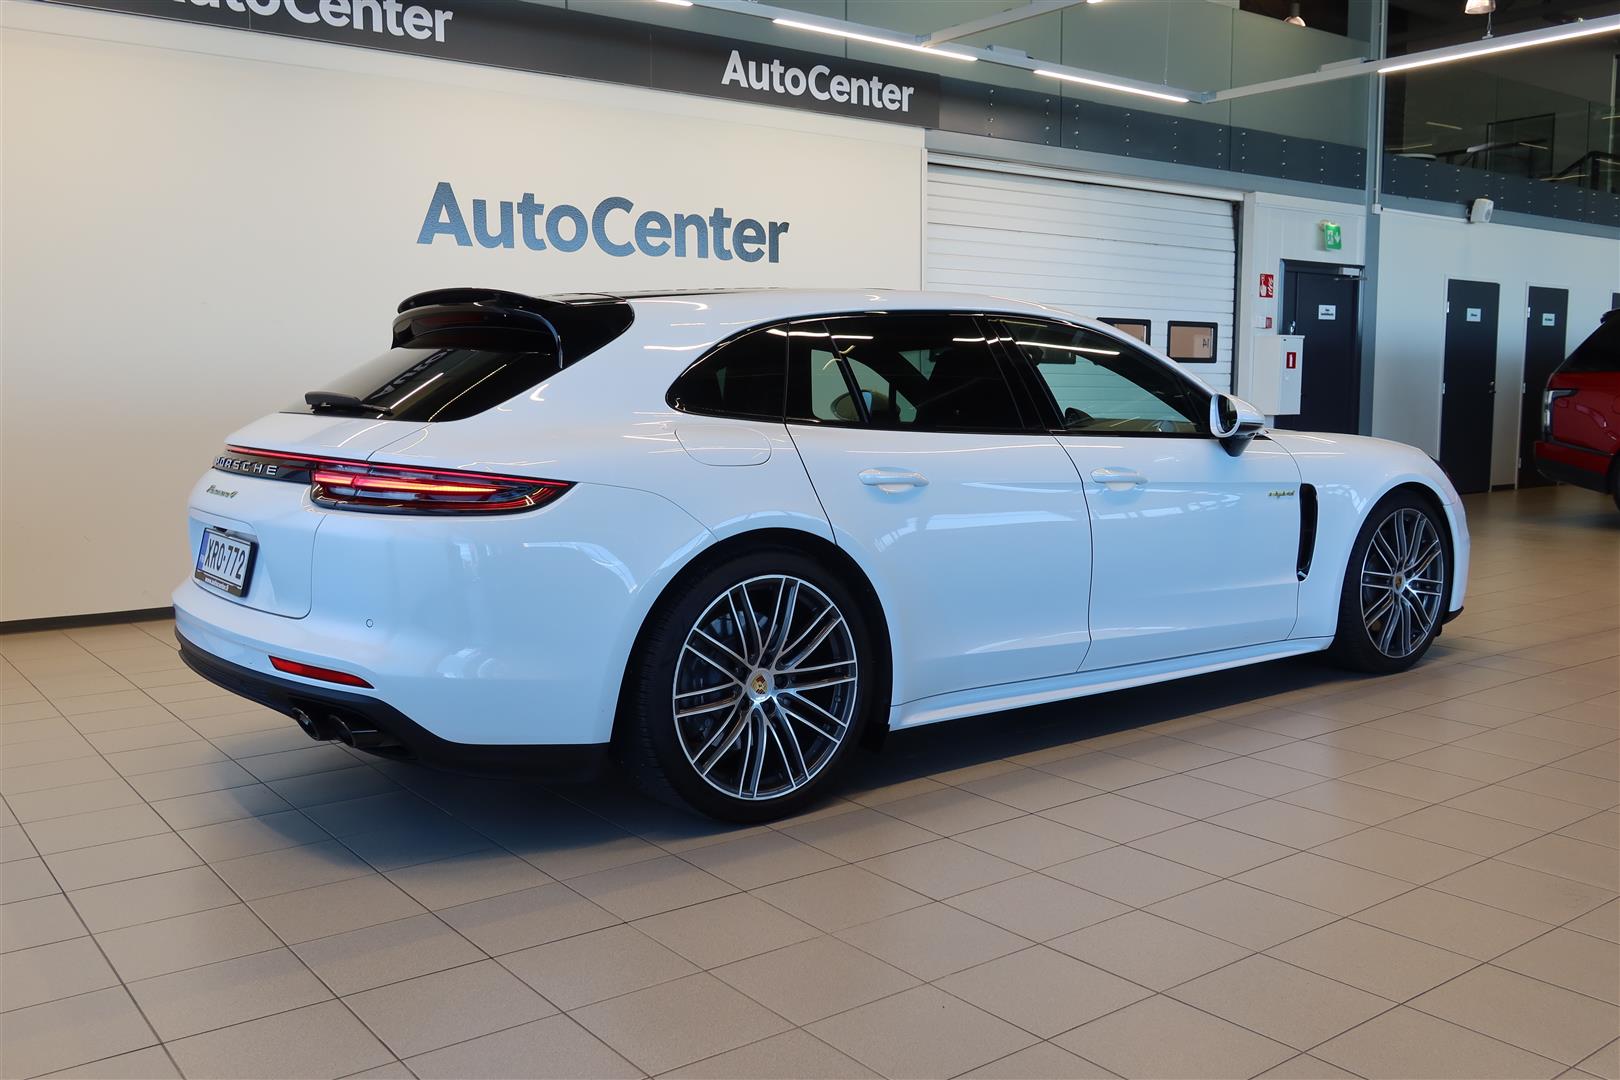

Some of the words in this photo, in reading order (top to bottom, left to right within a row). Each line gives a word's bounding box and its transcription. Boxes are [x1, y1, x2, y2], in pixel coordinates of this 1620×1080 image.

[174, 0, 454, 43] Center
[721, 50, 915, 112] AutoCenter
[417, 182, 790, 263] AutoCenter
[215, 457, 277, 475] PORSCHE
[205, 538, 246, 580] XRO-772
